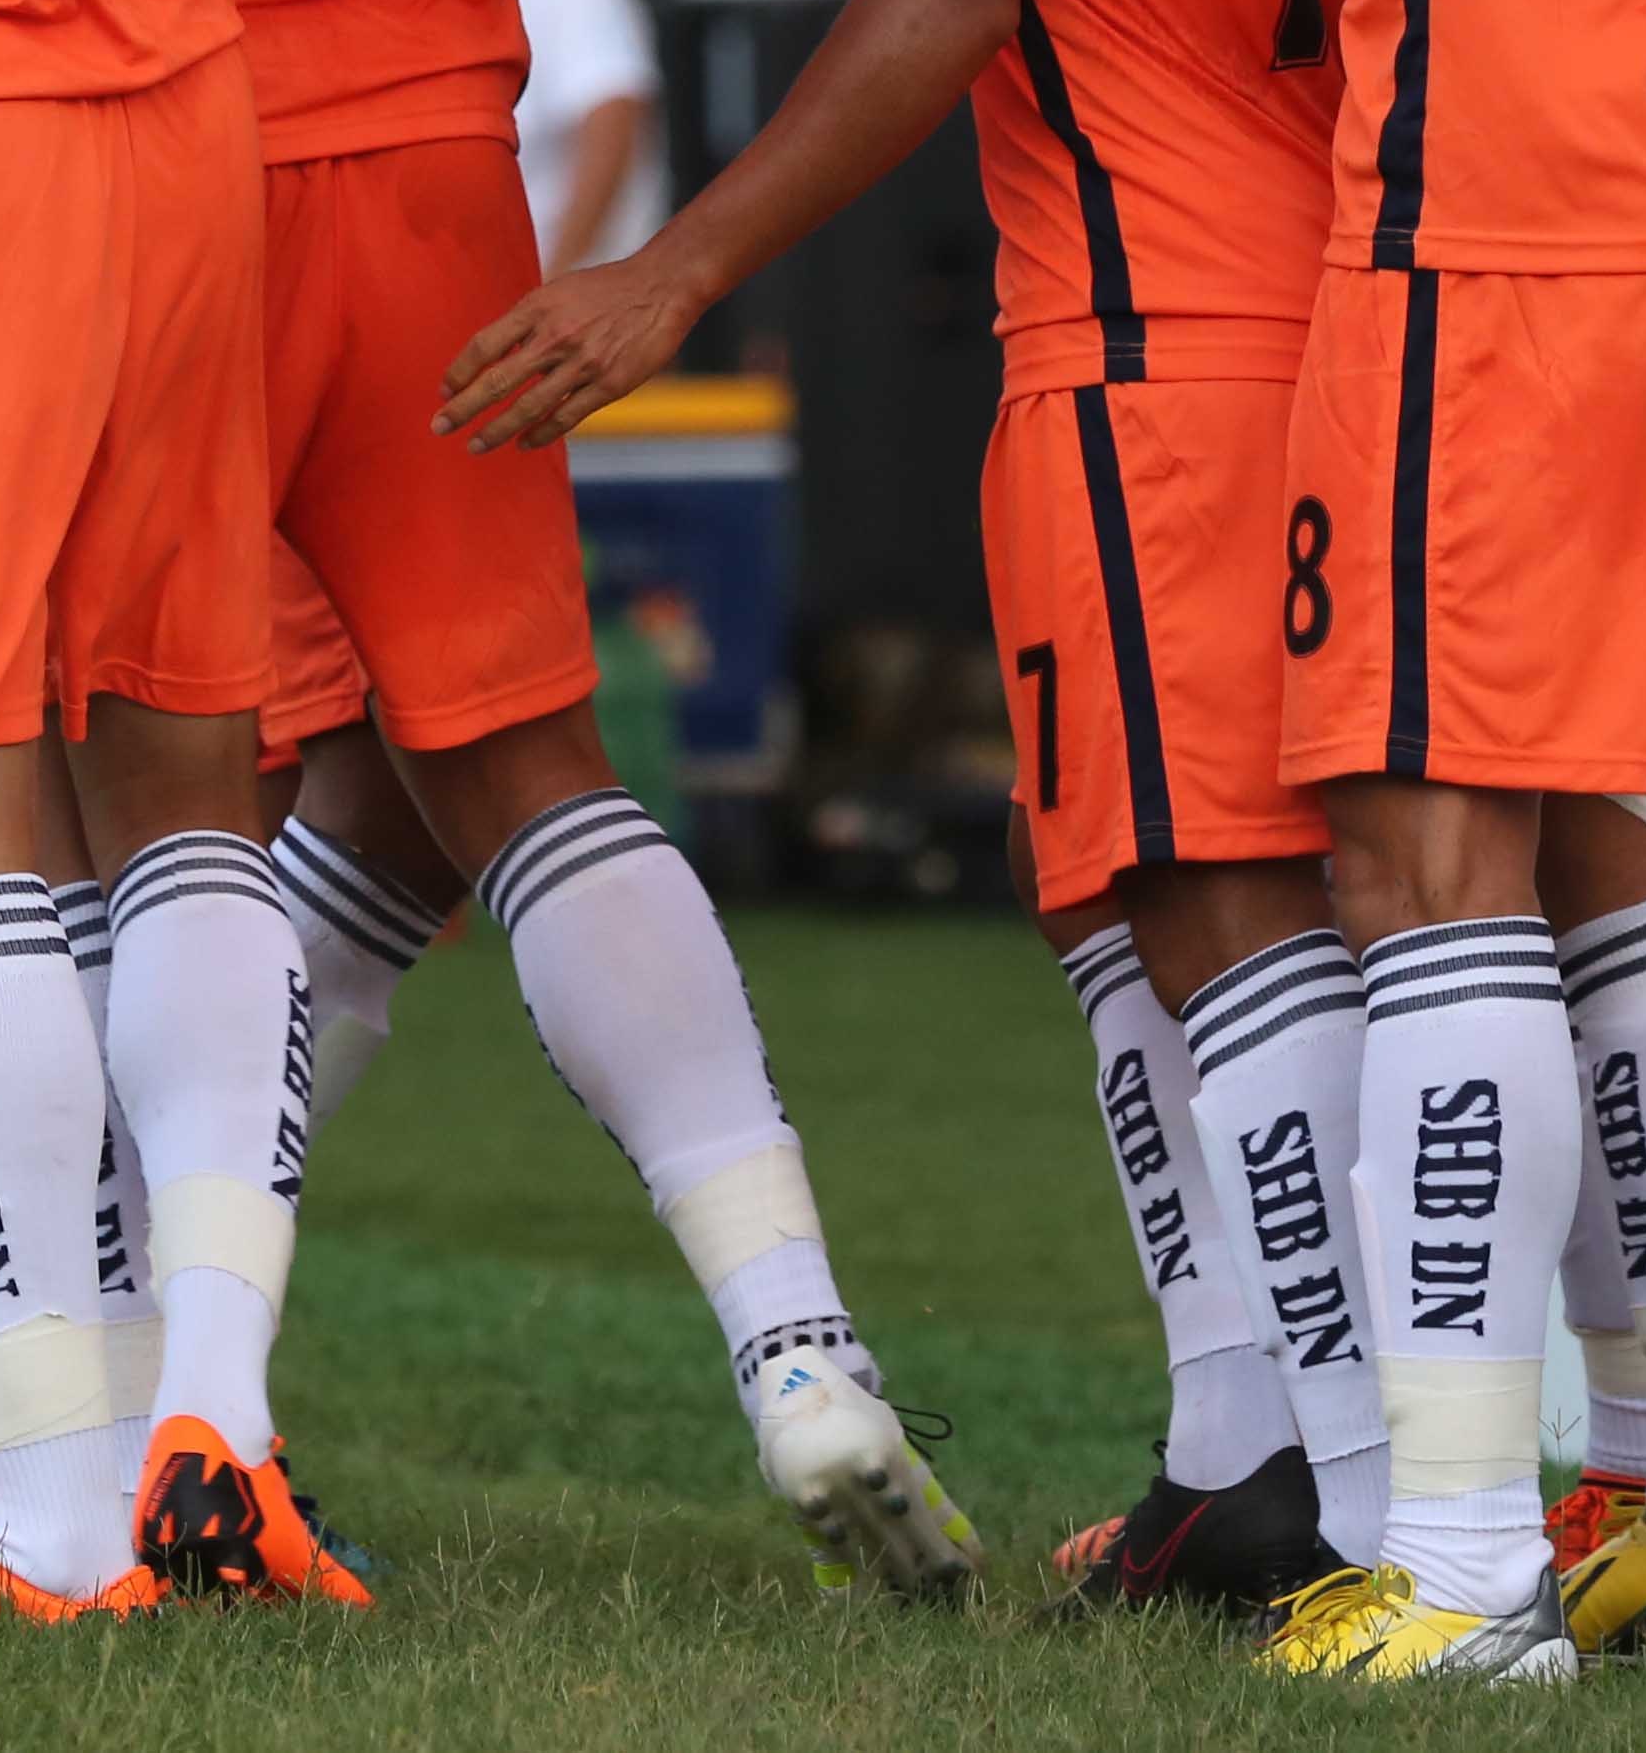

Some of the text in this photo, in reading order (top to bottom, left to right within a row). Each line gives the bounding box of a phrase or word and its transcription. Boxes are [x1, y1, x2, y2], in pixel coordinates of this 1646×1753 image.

[1284, 494, 1333, 659] 8
[1101, 1048, 1171, 1185] SHB
[1239, 1110, 1330, 1261] SHB
[1413, 1079, 1502, 1219] SHB
